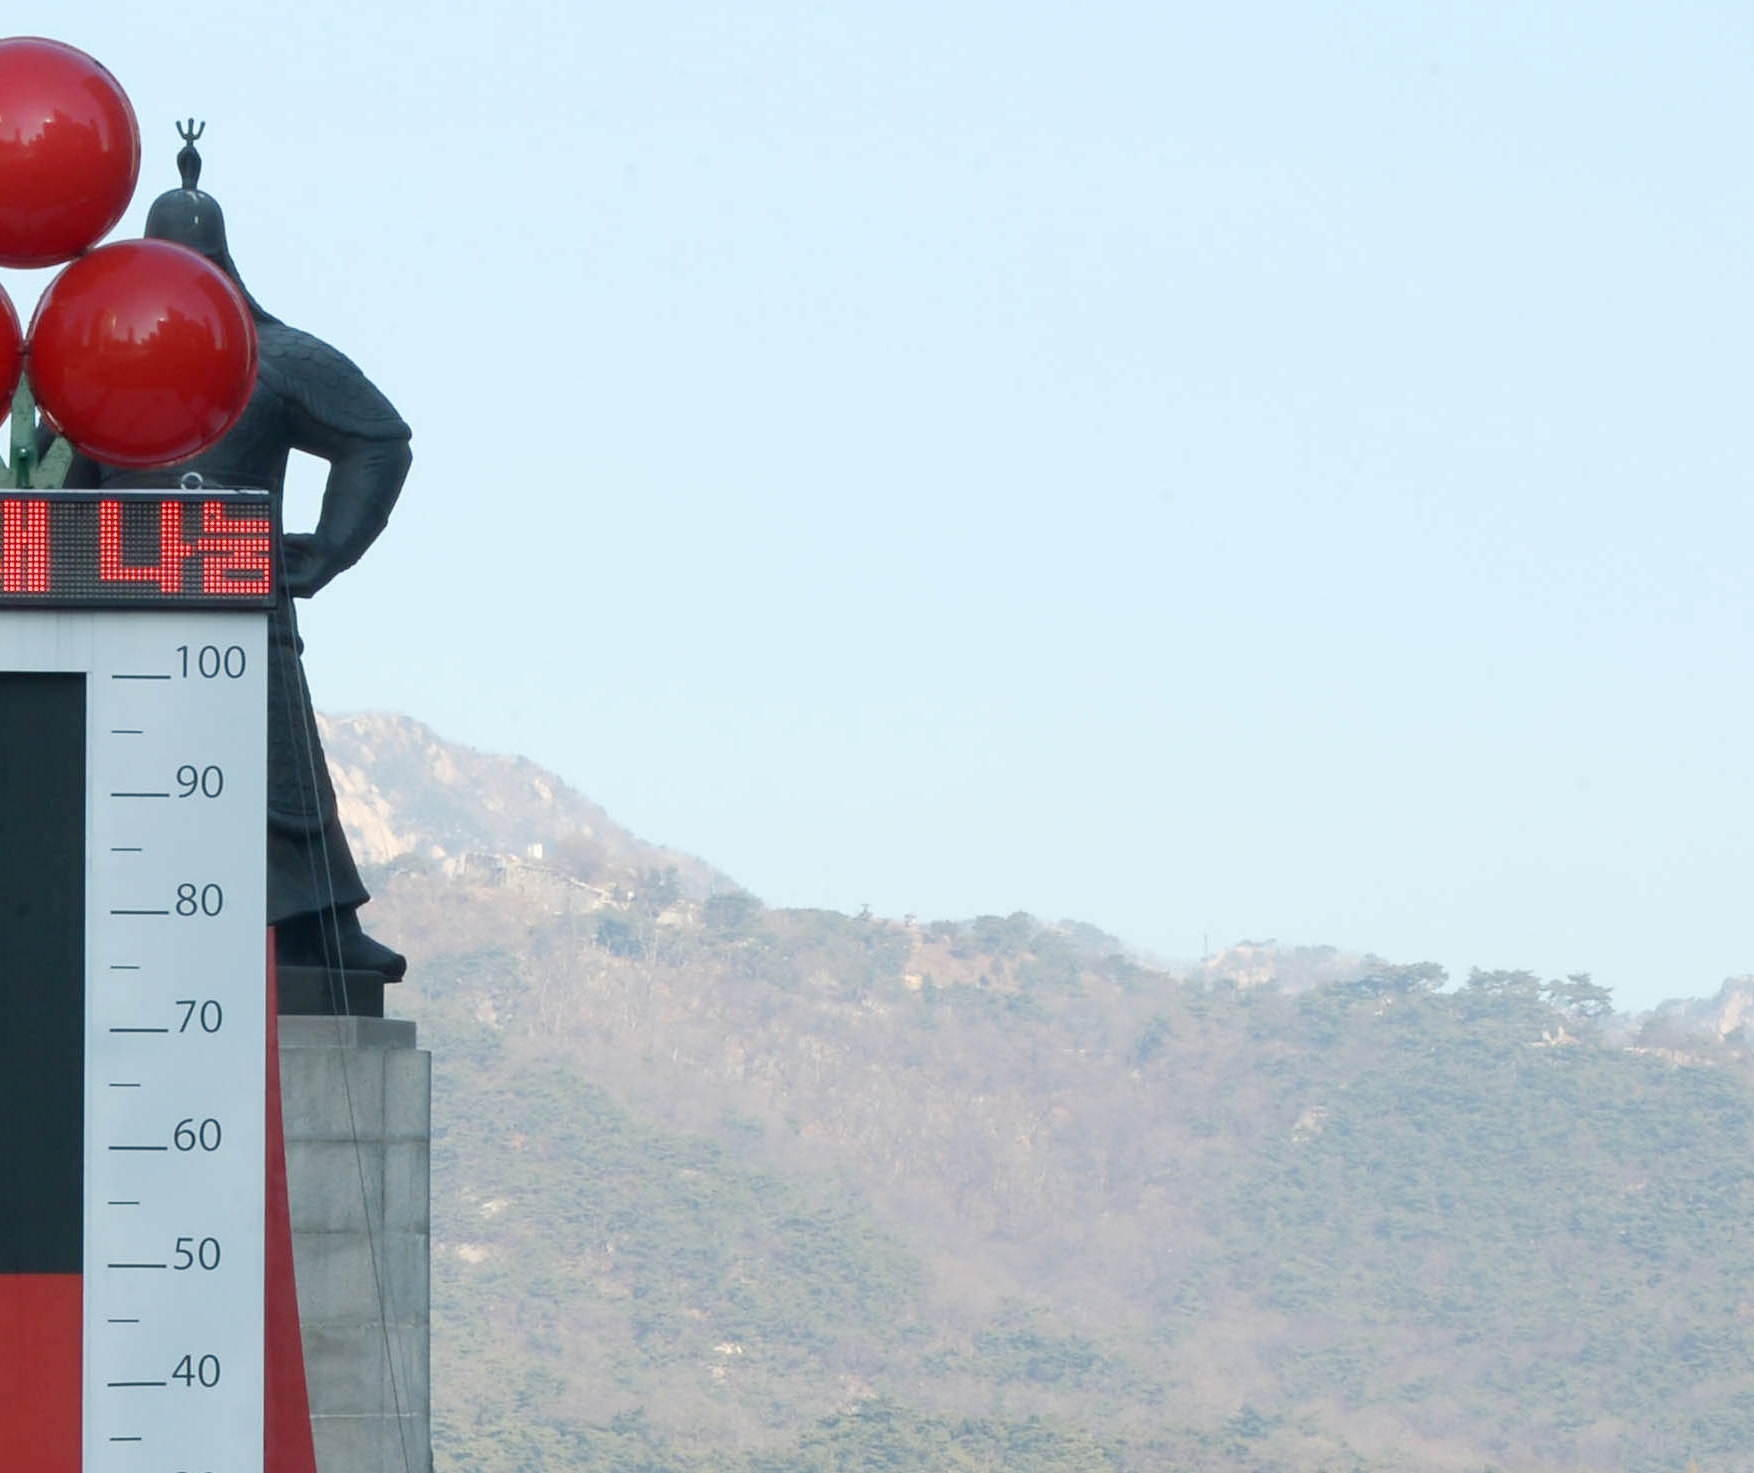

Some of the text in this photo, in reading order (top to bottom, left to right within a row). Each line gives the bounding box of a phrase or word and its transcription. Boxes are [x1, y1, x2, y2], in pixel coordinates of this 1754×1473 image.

[100, 500, 270, 594] 나눔
[176, 645, 246, 679] 100
[176, 765, 224, 798] 90
[176, 883, 223, 917] 80
[175, 1000, 223, 1034] 70
[173, 1118, 222, 1152] 60
[173, 1237, 221, 1271] 50
[172, 1354, 221, 1388] 40
